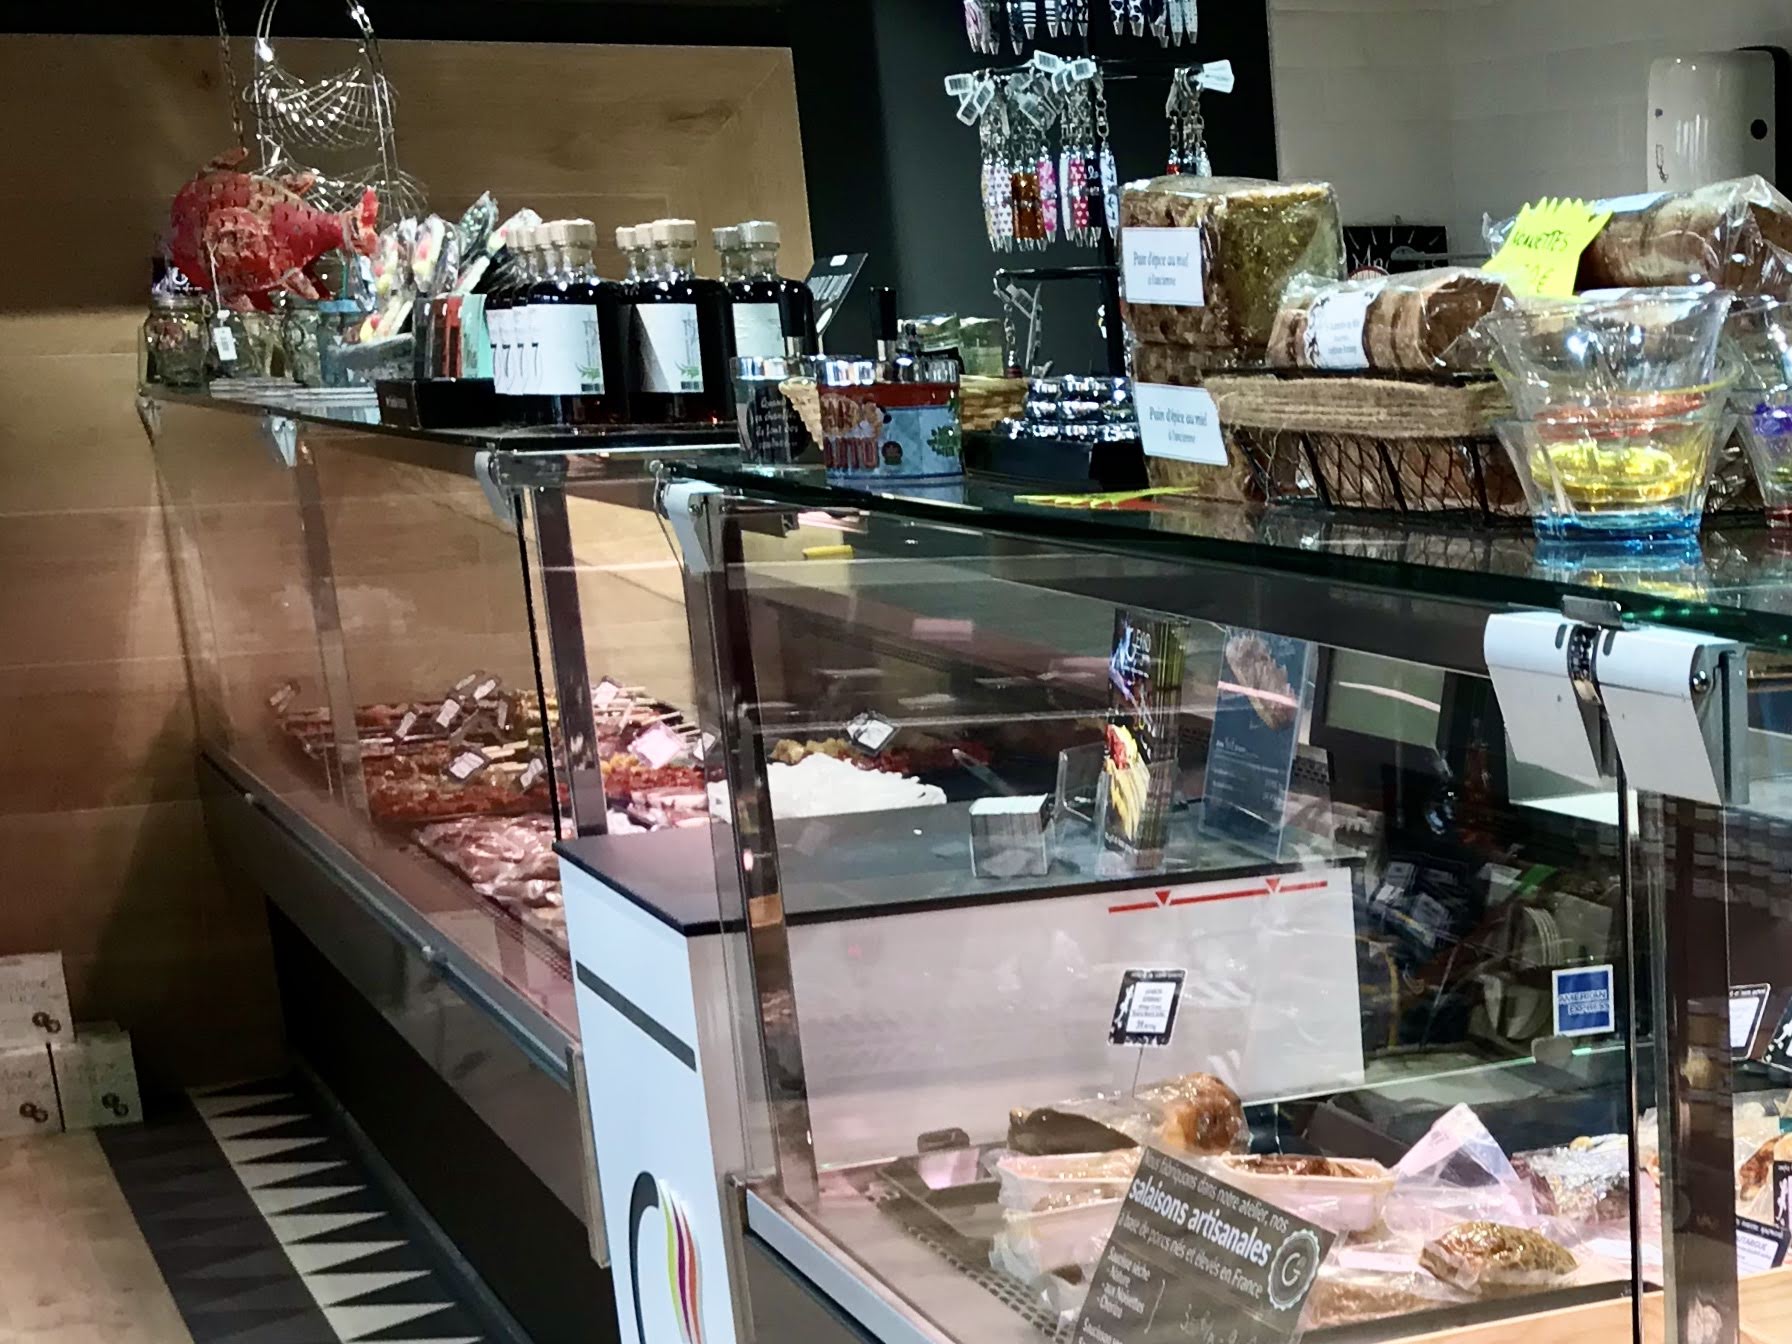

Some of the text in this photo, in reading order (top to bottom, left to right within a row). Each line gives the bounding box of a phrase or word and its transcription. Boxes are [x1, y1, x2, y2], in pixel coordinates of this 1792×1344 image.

[1149, 406, 1164, 421] Pain
[1558, 990, 1607, 1003] AMERICAN
[1569, 1001, 1609, 1014] EXPRESS
[1128, 1176, 1273, 1267] salaisons artisanales
[1197, 1174, 1217, 1199] dans
[1216, 1185, 1240, 1209] notre
[1238, 1197, 1269, 1227] atelier,
[1269, 1213, 1289, 1233] nos
[1147, 1227, 1171, 1253] porcs
[1170, 1237, 1186, 1257] nés
[1185, 1248, 1195, 1265] et
[1194, 1250, 1220, 1278] élevés
[1219, 1266, 1231, 1285] en
[1230, 1268, 1263, 1300] France
